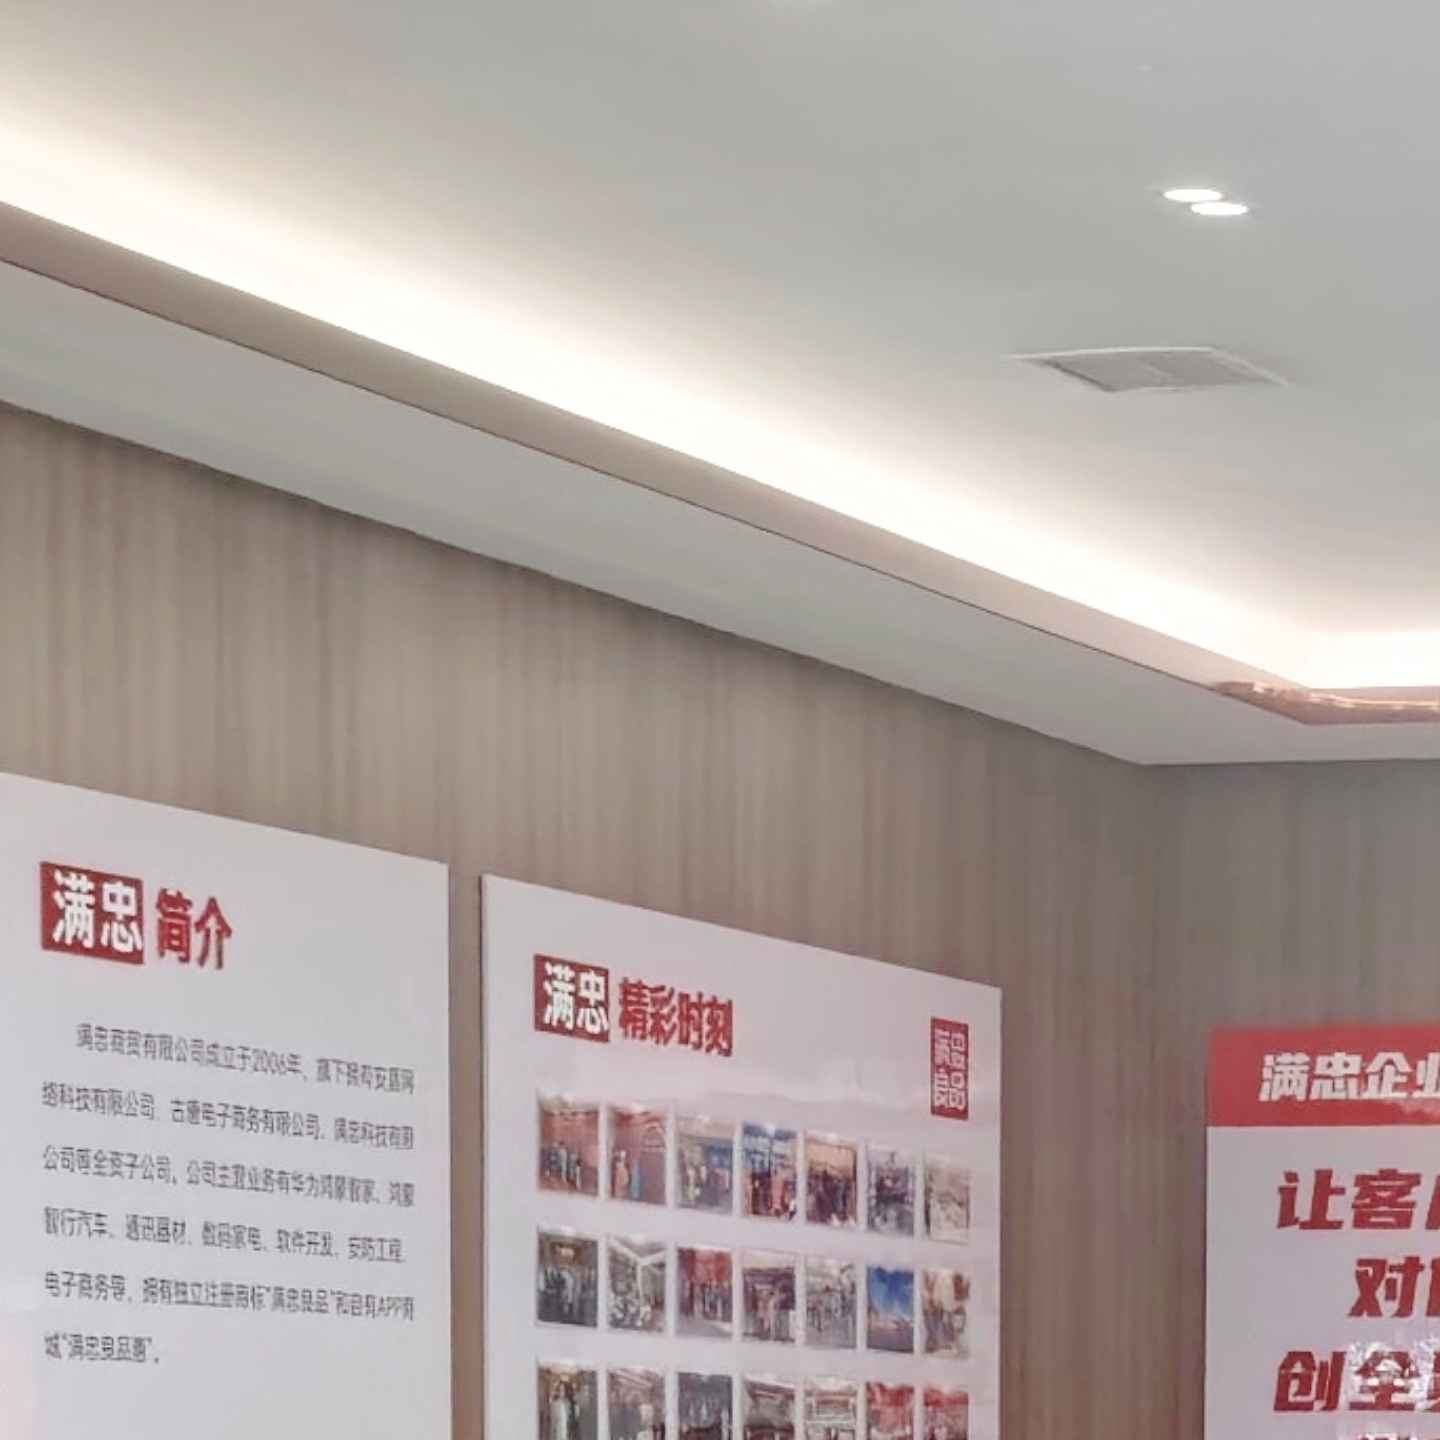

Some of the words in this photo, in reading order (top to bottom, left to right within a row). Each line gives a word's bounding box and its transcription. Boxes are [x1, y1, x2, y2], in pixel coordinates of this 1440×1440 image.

[53, 868, 142, 954] 满忠
[157, 887, 233, 970] 简介
[544, 961, 610, 1036] 满忠
[618, 976, 733, 1058] 精彩时刻
